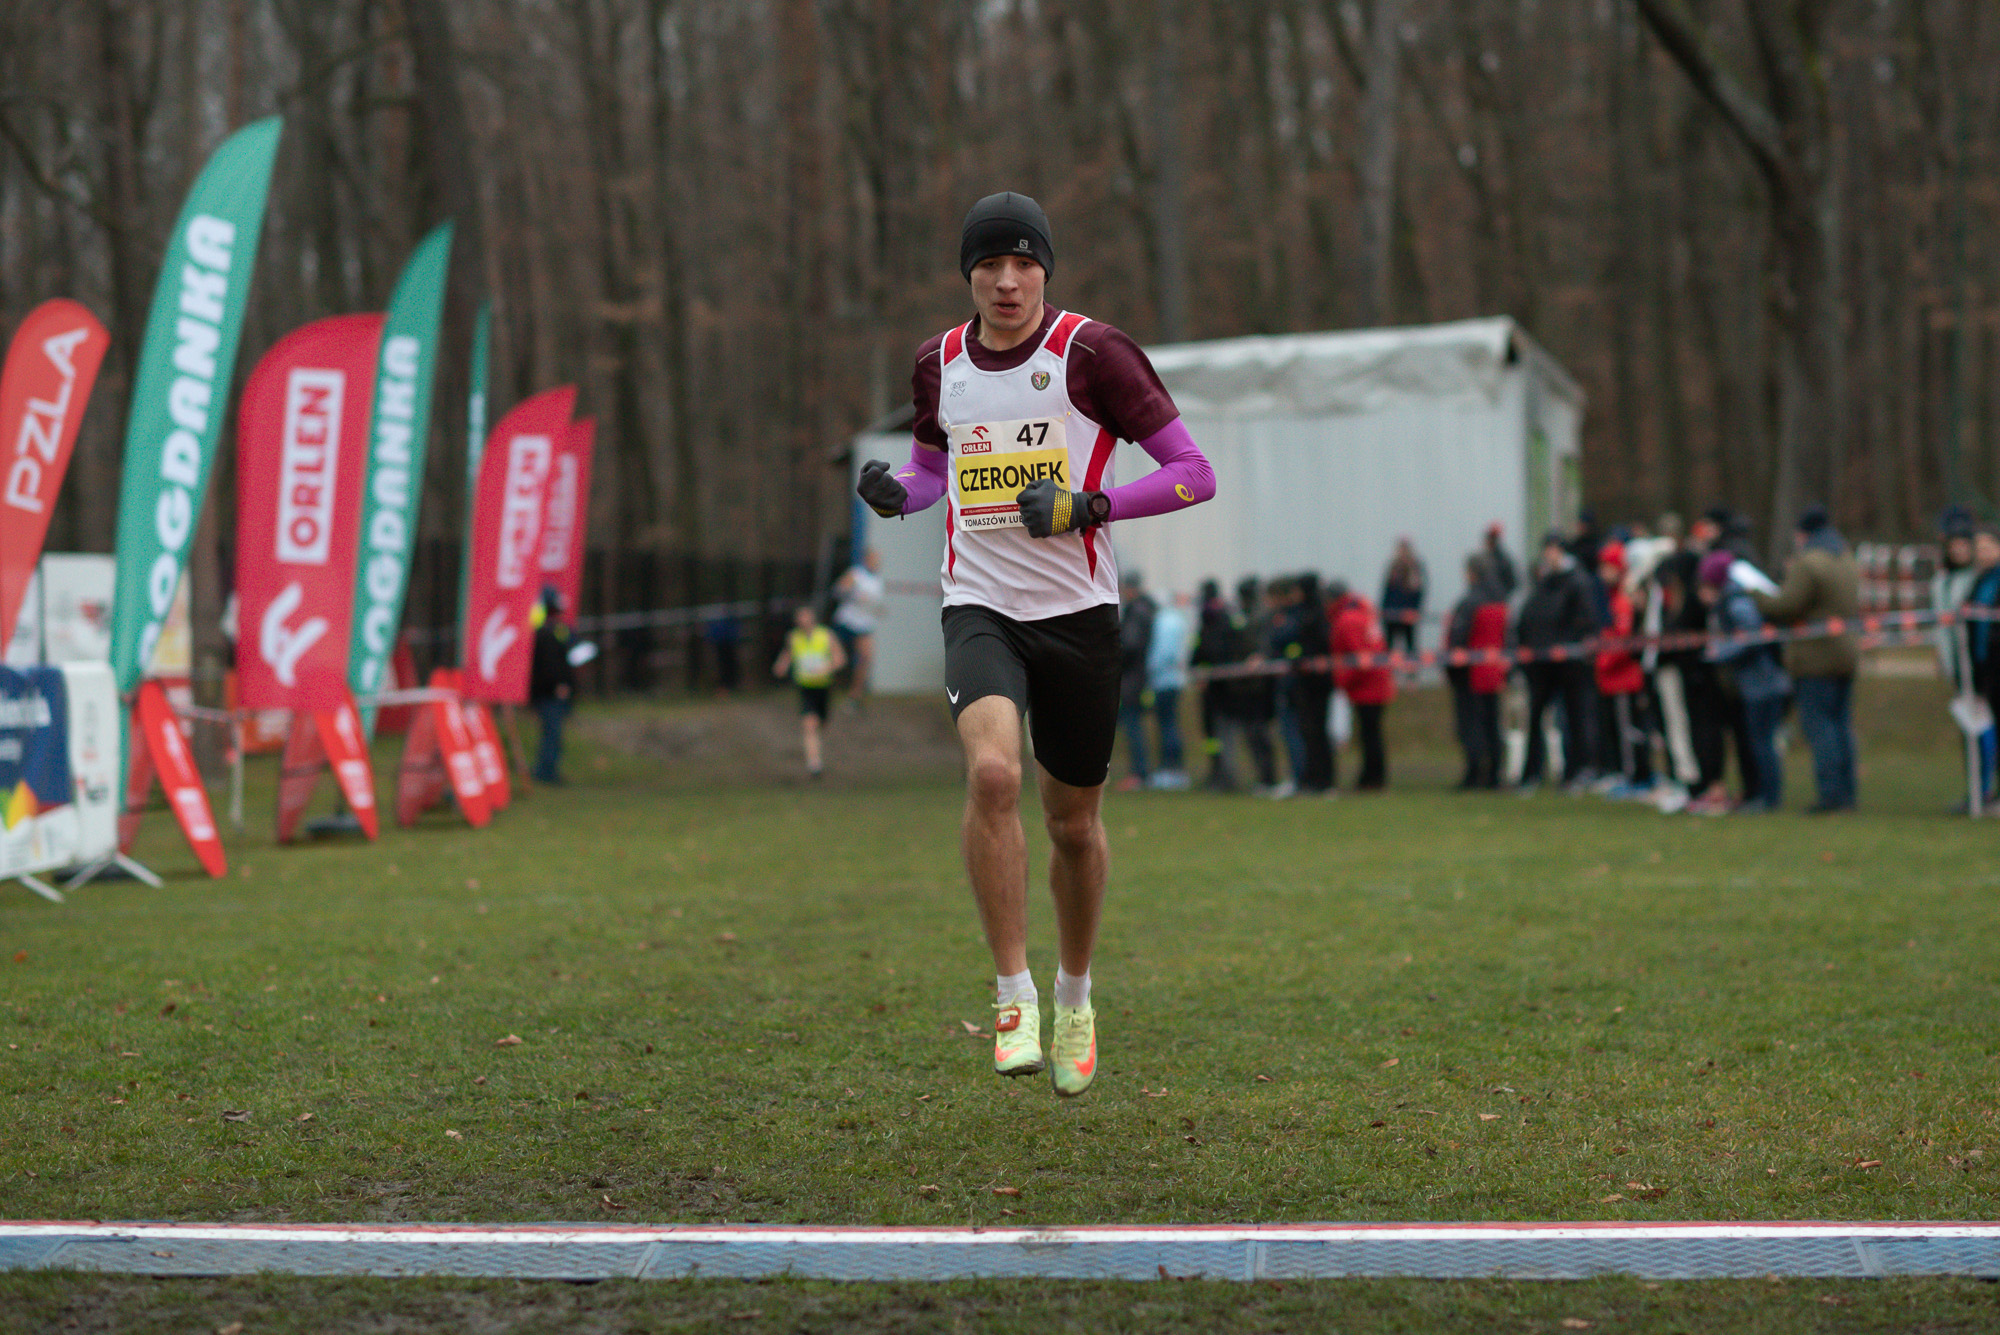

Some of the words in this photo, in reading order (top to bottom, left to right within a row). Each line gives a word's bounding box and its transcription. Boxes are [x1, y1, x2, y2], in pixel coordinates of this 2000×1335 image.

[5, 327, 90, 514] PZLA
[1016, 422, 1050, 447] 47
[962, 442, 990, 454] ORLEN
[289, 386, 332, 548] ORLEN
[960, 460, 1065, 493] CZERONEK
[965, 513, 1007, 528] TOMASZÓW
